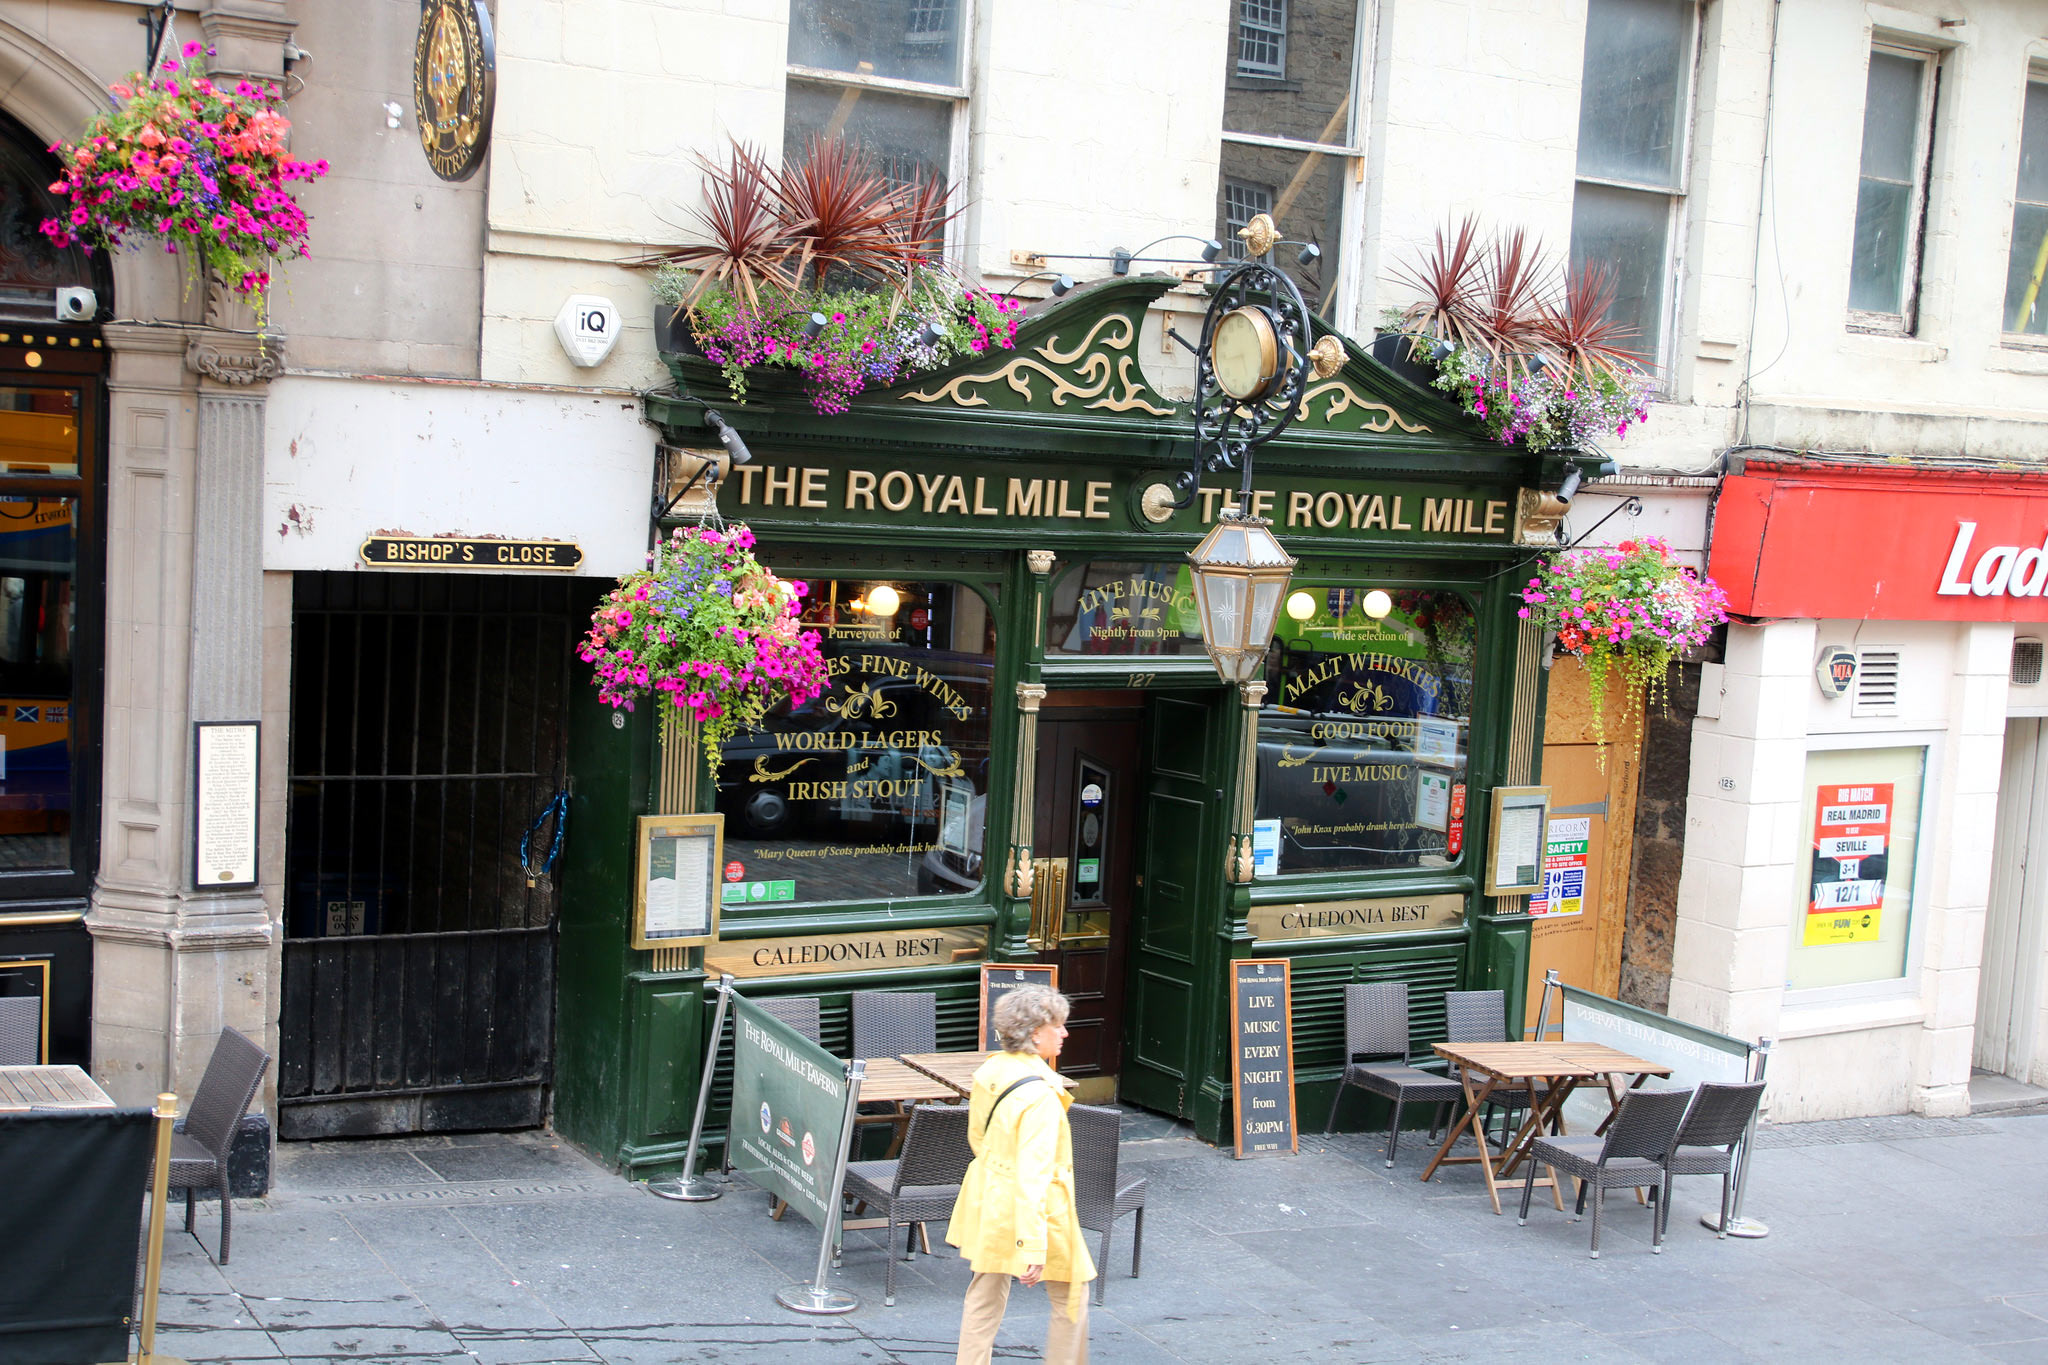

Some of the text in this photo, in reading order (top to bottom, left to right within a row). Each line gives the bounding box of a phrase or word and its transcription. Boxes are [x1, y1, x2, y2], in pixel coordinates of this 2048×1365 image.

[432, 146, 469, 176] MITRE
[581, 310, 606, 333] iQ
[732, 464, 1112, 519] THE ROYAL MILE
[1198, 488, 1508, 534] THE ROYAL MILE
[386, 542, 556, 564] BISHOP'S CLOSE
[1936, 521, 2048, 598] Lad
[1077, 578, 1192, 615] LIVE MUSIC
[828, 627, 901, 643] Purveyors of
[1089, 626, 1180, 641] Nightly from 9pm
[1332, 630, 1409, 642] Wide selection of
[1126, 673, 1156, 688] 127
[1285, 651, 1442, 702] MALT WHISKIES
[861, 654, 911, 680] FINE
[914, 665, 973, 722] WINES
[1310, 720, 1416, 740] GOOD FOOD
[774, 729, 942, 751] WORLD LAGERS
[1352, 745, 1372, 760] and
[846, 757, 870, 775] and
[1312, 764, 1409, 784] LIVE MUSIC
[787, 778, 924, 801] IRISH STOUT
[1721, 778, 1735, 789] 125
[1838, 787, 1874, 803] BIG MATCH
[1827, 808, 1881, 822] REAL MADRID
[1313, 823, 1333, 834] Knox
[1333, 822, 1366, 835] probably
[1366, 821, 1388, 831] drank
[1548, 821, 1587, 833] RICORN
[753, 848, 784, 862] “Mary
[786, 848, 816, 860] Queen
[817, 844, 829, 859] of
[829, 846, 853, 857] Scots
[855, 843, 896, 857] probably
[896, 842, 923, 853] drank
[1547, 842, 1583, 854] SAFETY
[1836, 840, 1867, 853] SEVILLE
[1841, 863, 1856, 875] 3-1
[1834, 885, 1861, 903] 12/1
[1280, 904, 1430, 930] CALEDONIA BEST
[1833, 919, 1851, 929] FUN
[752, 937, 944, 967] CALEDONIA BEST
[1248, 996, 1275, 1009] LIVE
[1244, 1020, 1280, 1034] MUSIC
[743, 1018, 839, 1099] THE ROYAL MILE TAVERN
[1244, 1045, 1281, 1059] EVERY
[1243, 1070, 1283, 1085] NIGHT
[1252, 1096, 1276, 1109] from
[1246, 1120, 1284, 1135] 9.30PM
[757, 1136, 772, 1154] LOCAL
[772, 1147, 783, 1161] ALES
[787, 1157, 801, 1176] CRAFT
[801, 1168, 814, 1186] BEERS
